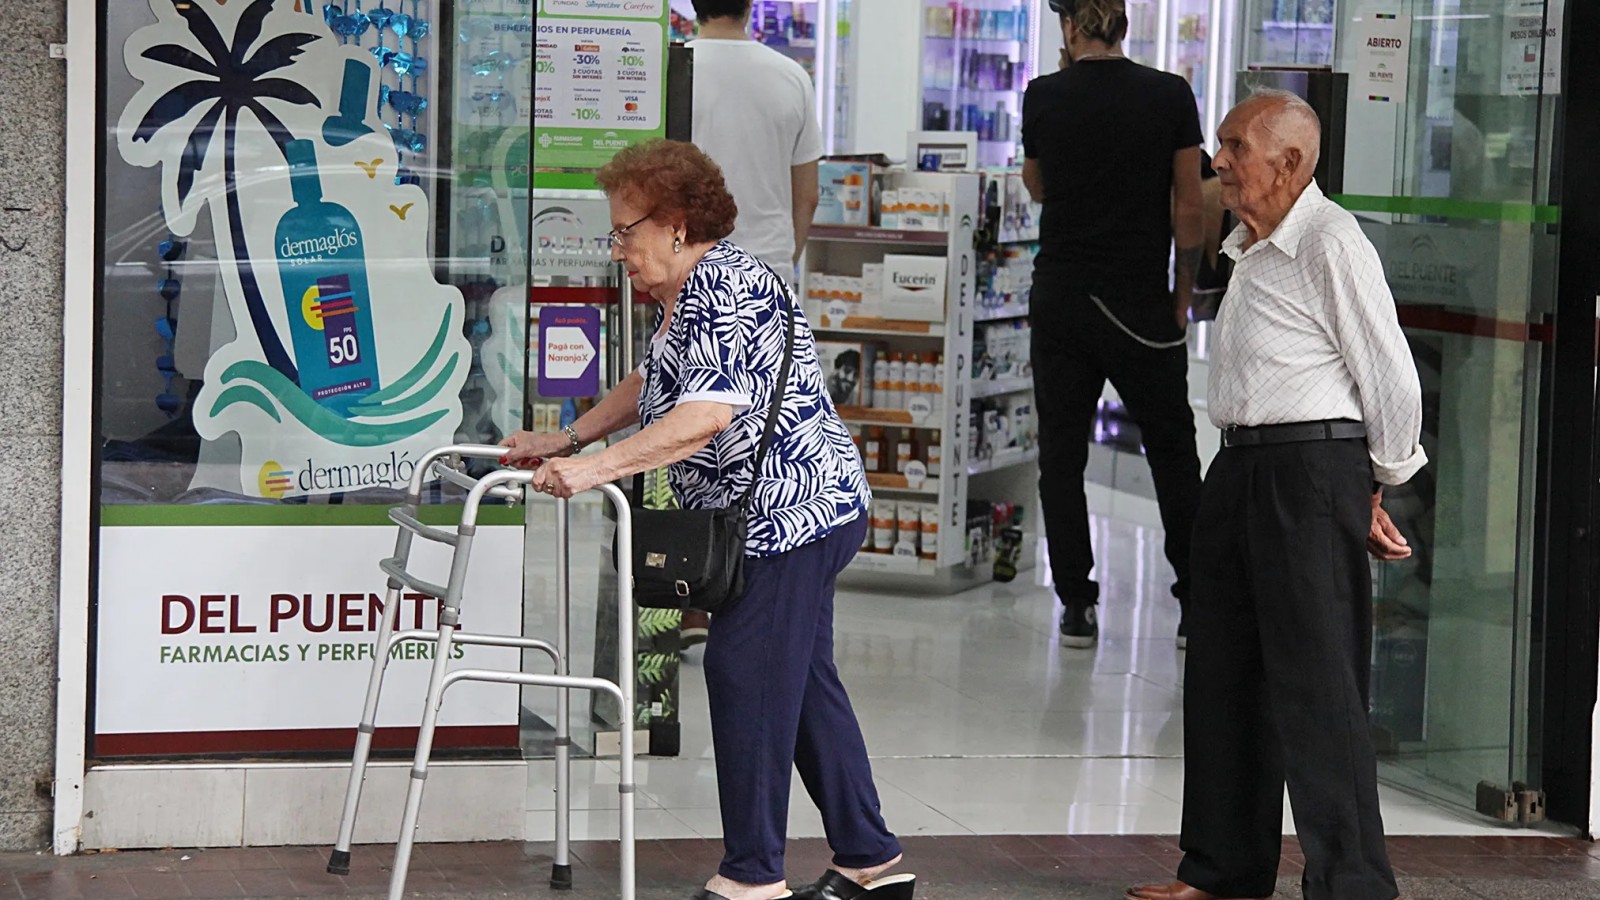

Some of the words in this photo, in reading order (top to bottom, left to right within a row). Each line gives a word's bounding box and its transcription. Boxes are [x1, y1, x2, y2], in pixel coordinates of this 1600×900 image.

[555, 26, 569, 34] EN
[571, 27, 632, 36] PERFUMERÍA
[1367, 37, 1402, 49] ABIERTO
[573, 54, 600, 65] -30%
[617, 56, 645, 67] -10%
[571, 108, 601, 120] -10%
[281, 228, 358, 257] dermaglós
[290, 254, 323, 267] SOLAR
[892, 272, 937, 285] Eucerin
[957, 254, 970, 336] DEL
[330, 334, 358, 364] 50
[548, 342, 568, 352] Pagá
[353, 381, 367, 389] ALTA
[951, 353, 965, 527] PUENTE
[298, 450, 420, 492] dermagló
[161, 594, 257, 635] DEL
[160, 643, 289, 664] FARMACIAS
[298, 643, 310, 662] Y
